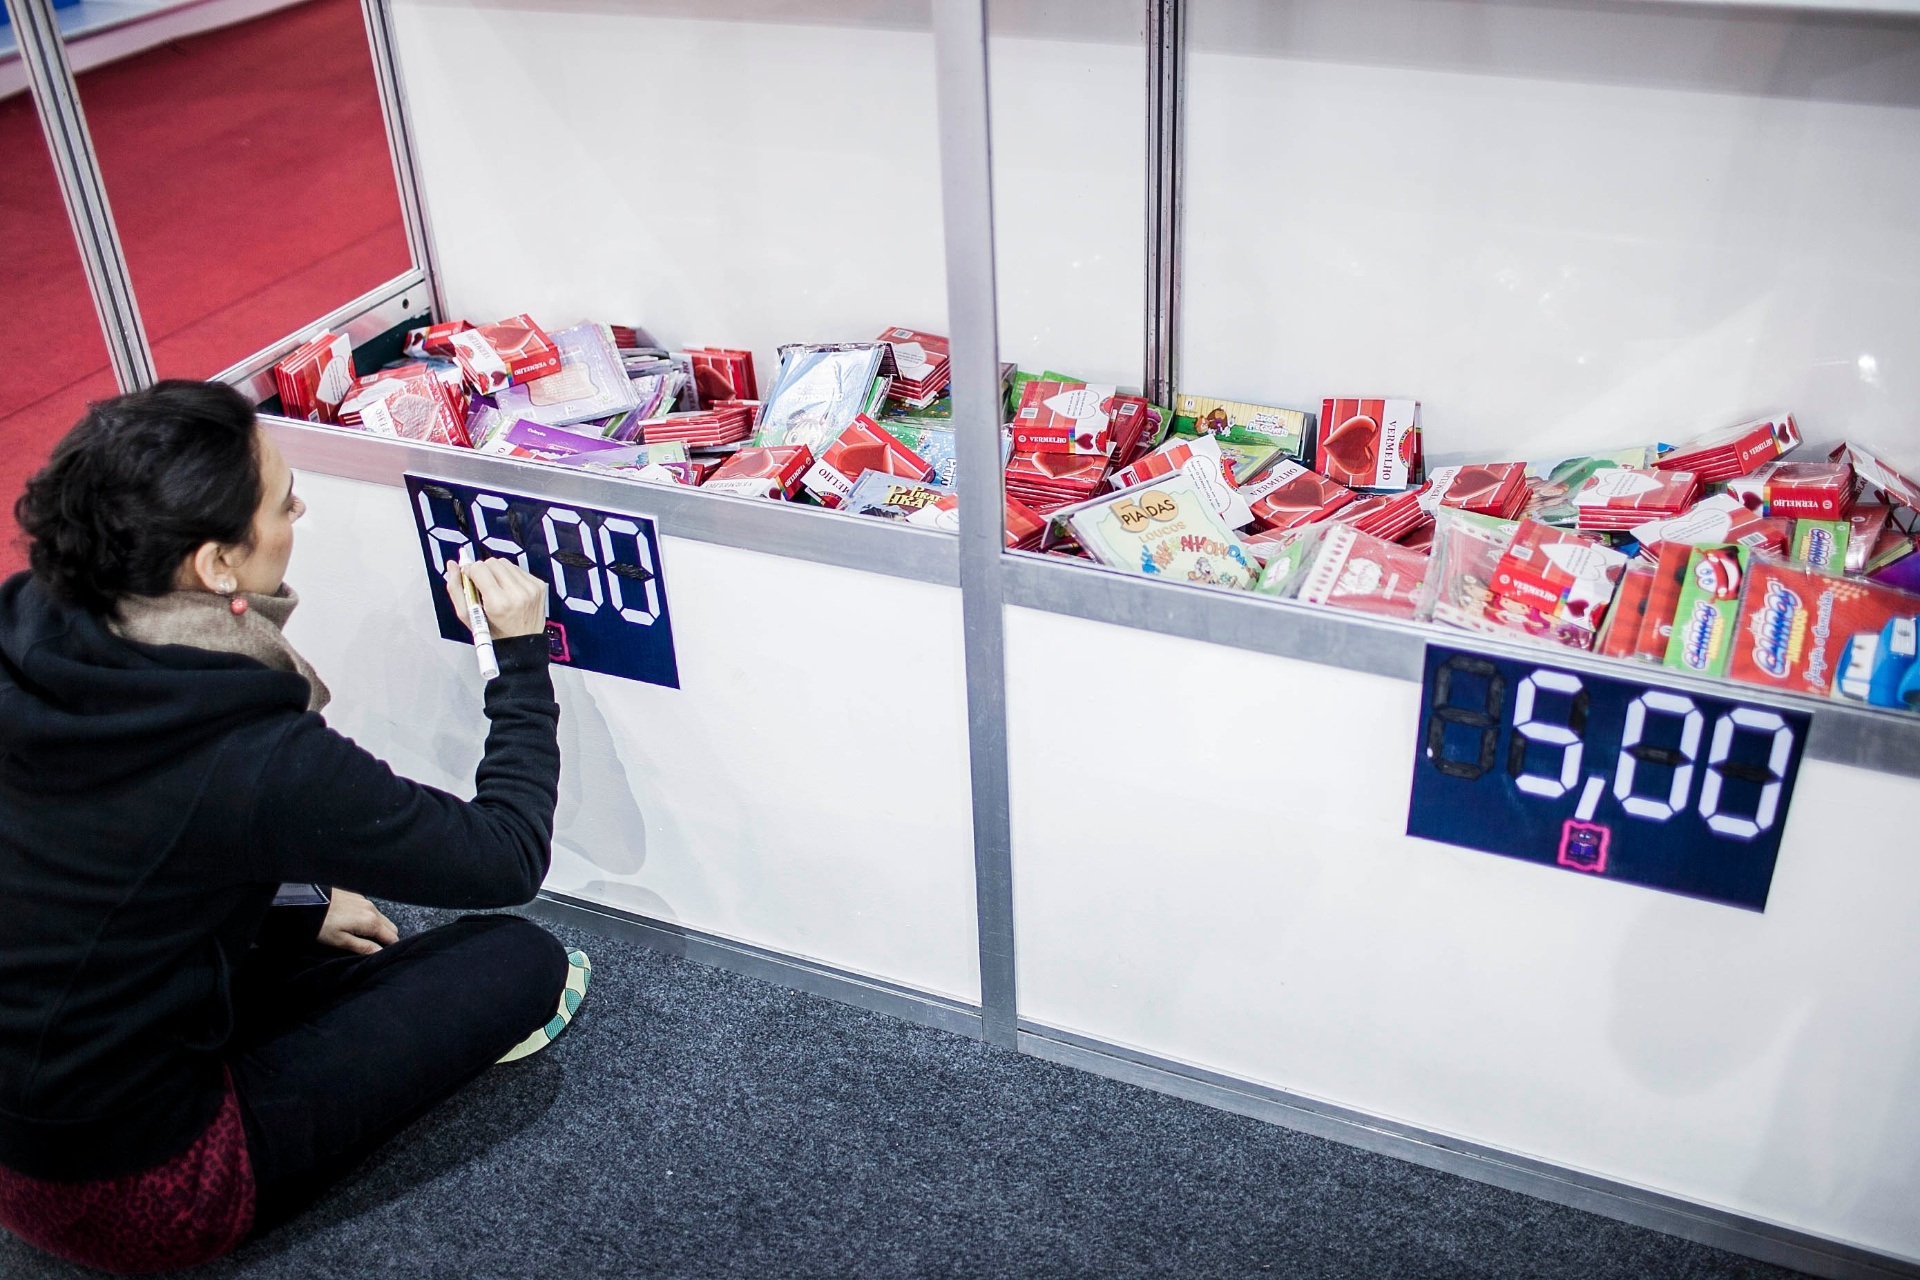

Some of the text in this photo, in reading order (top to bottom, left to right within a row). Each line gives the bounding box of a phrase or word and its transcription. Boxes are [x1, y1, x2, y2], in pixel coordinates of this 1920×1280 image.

[513, 361, 547, 376] VERMELHO
[1029, 436, 1067, 444] VERMELHO
[1382, 420, 1397, 481] VERMELHO
[1749, 437, 1773, 456] VERMELHO
[785, 465, 806, 488] VERMELHO
[1250, 467, 1298, 497] VERMELHO
[1428, 469, 1454, 501] VERMELHO
[1121, 499, 1176, 525] PIADAS
[1773, 499, 1819, 508] VERMELHO
[1138, 521, 1187, 544] LOUCOS
[1512, 579, 1558, 602] VERMELHO
[1755, 582, 1798, 676] CARROS
[1513, 669, 1795, 839] 5,00
